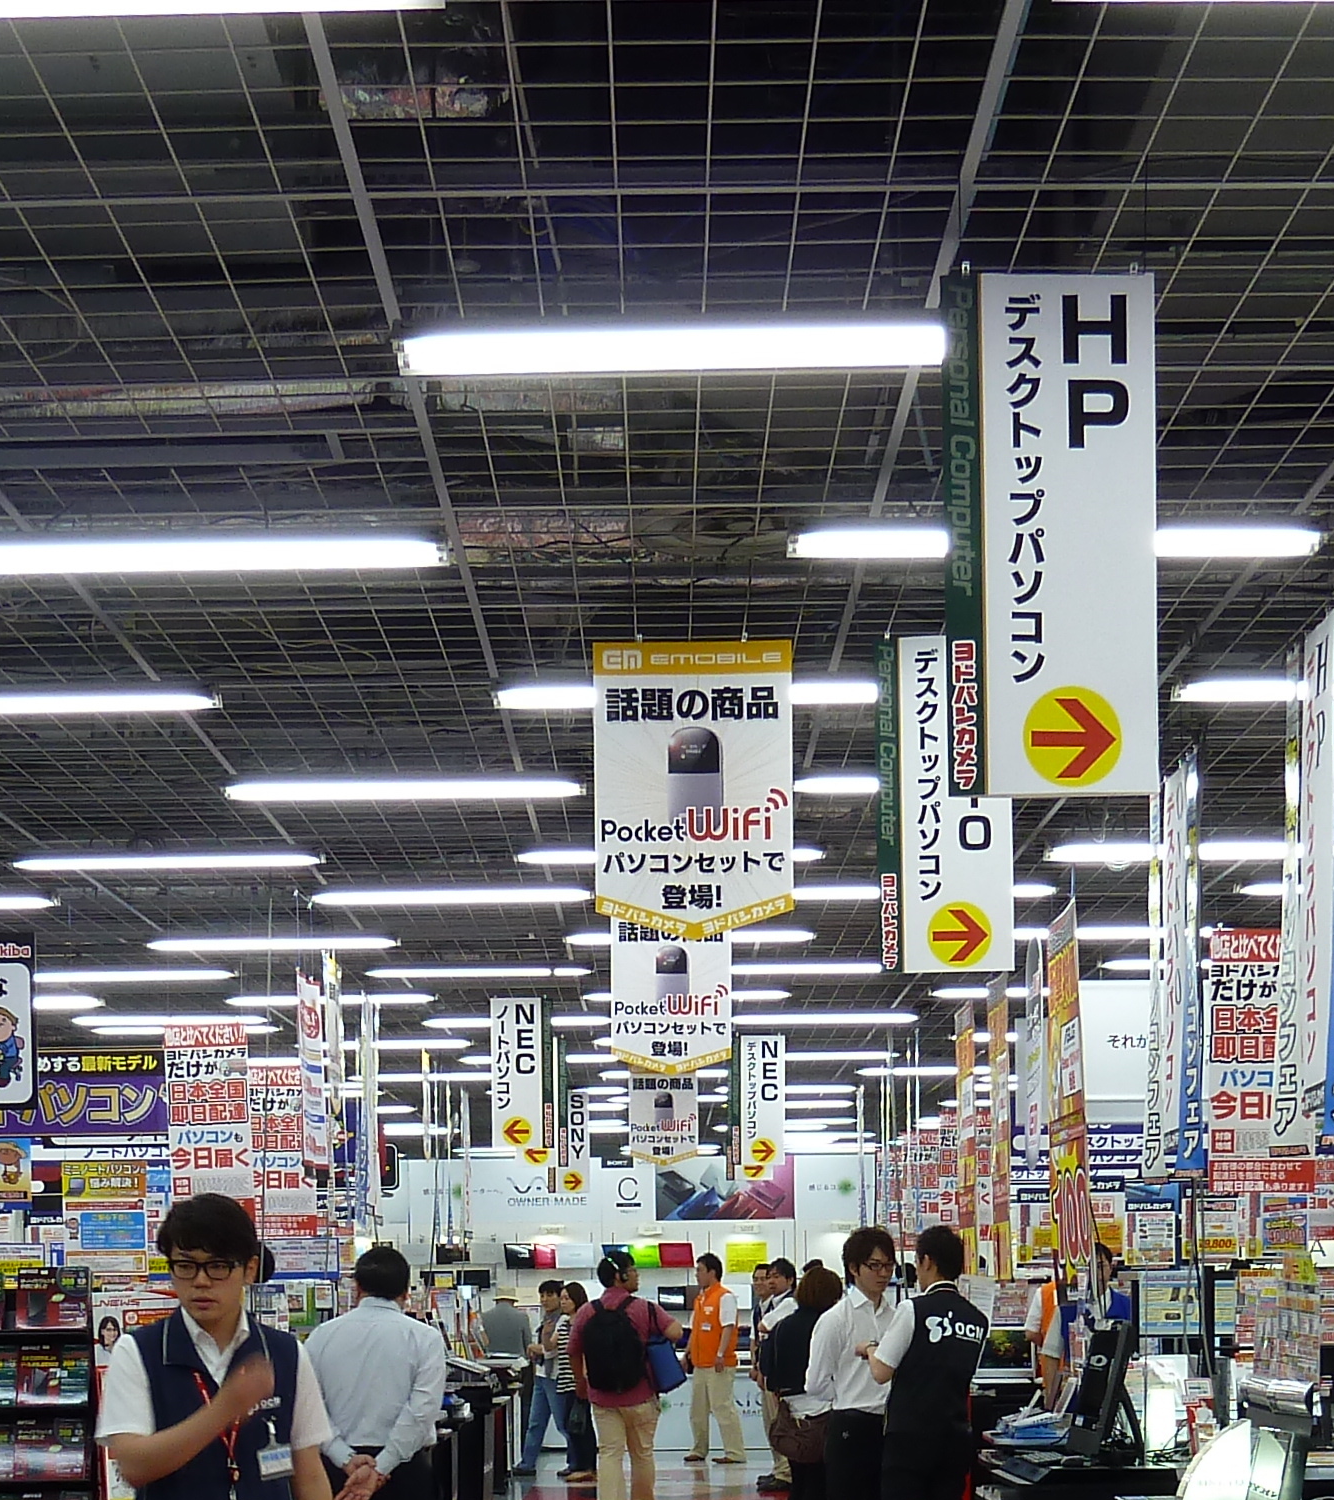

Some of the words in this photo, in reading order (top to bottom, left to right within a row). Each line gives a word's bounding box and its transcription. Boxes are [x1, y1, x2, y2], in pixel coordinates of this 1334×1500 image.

[1060, 294, 1130, 449] HP
[1004, 294, 1047, 684] デスクトップパソコン
[650, 650, 782, 669] EMOBILE
[605, 686, 779, 723] 話題の商品
[951, 639, 977, 790] ヨドバシカメラ
[913, 648, 943, 901] デスクトップパソコン
[600, 816, 685, 844] Pocket
[685, 802, 773, 844] WiFi
[602, 849, 786, 876] パソコンセットで
[661, 884, 723, 910] 登場!
[601, 900, 687, 934] ヨドバシカメラ
[700, 896, 787, 934] ヨドバシカメラ
[880, 873, 898, 970] ヨドバシカメラ
[1211, 979, 1277, 1001] だけが
[614, 1001, 665, 1016] Pocket
[667, 994, 719, 1017] WiFi
[515, 1003, 536, 1076] NEC
[616, 1021, 727, 1036] パソコンセットで
[167, 1048, 247, 1060] ヨドバシカメラ
[496, 1005, 511, 1110] ノートパソコン
[650, 1041, 688, 1057] 登場!
[167, 1061, 219, 1078] だけが
[761, 1040, 779, 1102] NEC
[170, 1080, 246, 1102] 日本全国
[632, 1077, 694, 1090] 話題の商品
[747, 1042, 757, 1140] デスクトップパソコン
[170, 1103, 248, 1124] 即日配達
[176, 1130, 244, 1145] パソコンも
[570, 1094, 585, 1160] SONY
[631, 1135, 696, 1144] パソコンセットで
[170, 1147, 251, 1170] 今日届く
[652, 1146, 674, 1156] 登場!
